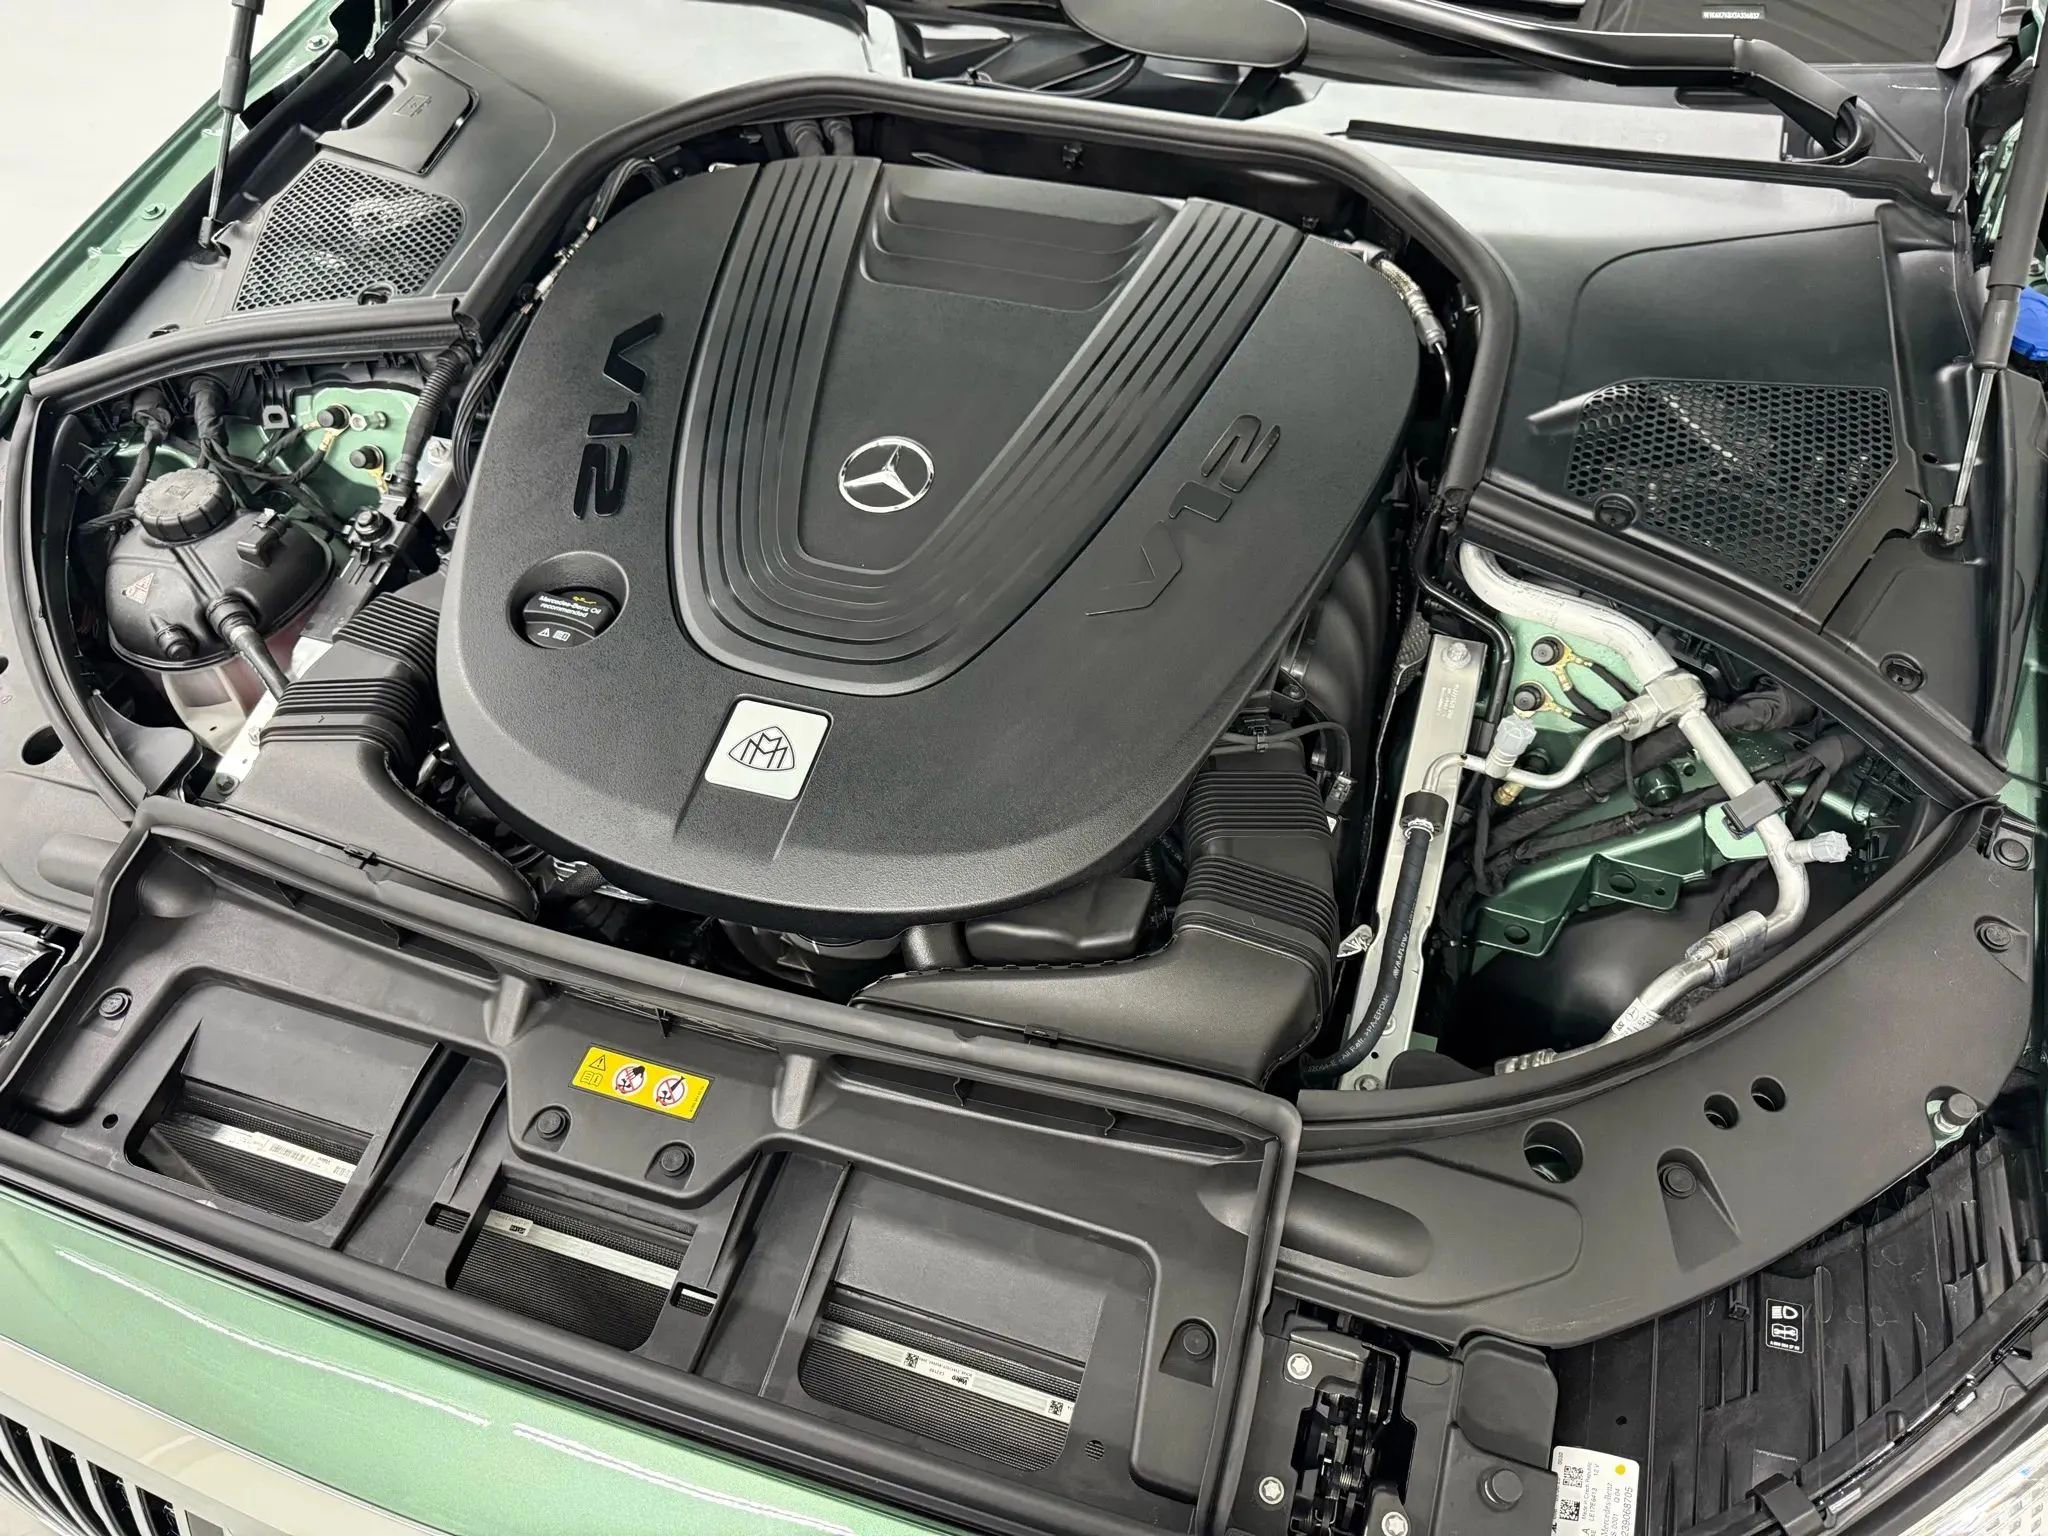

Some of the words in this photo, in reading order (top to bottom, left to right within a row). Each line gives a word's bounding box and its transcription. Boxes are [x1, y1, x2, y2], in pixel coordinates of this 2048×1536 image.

[573, 311, 664, 519] V12
[1085, 413, 1280, 616] V12
[540, 603, 588, 617] recommended
